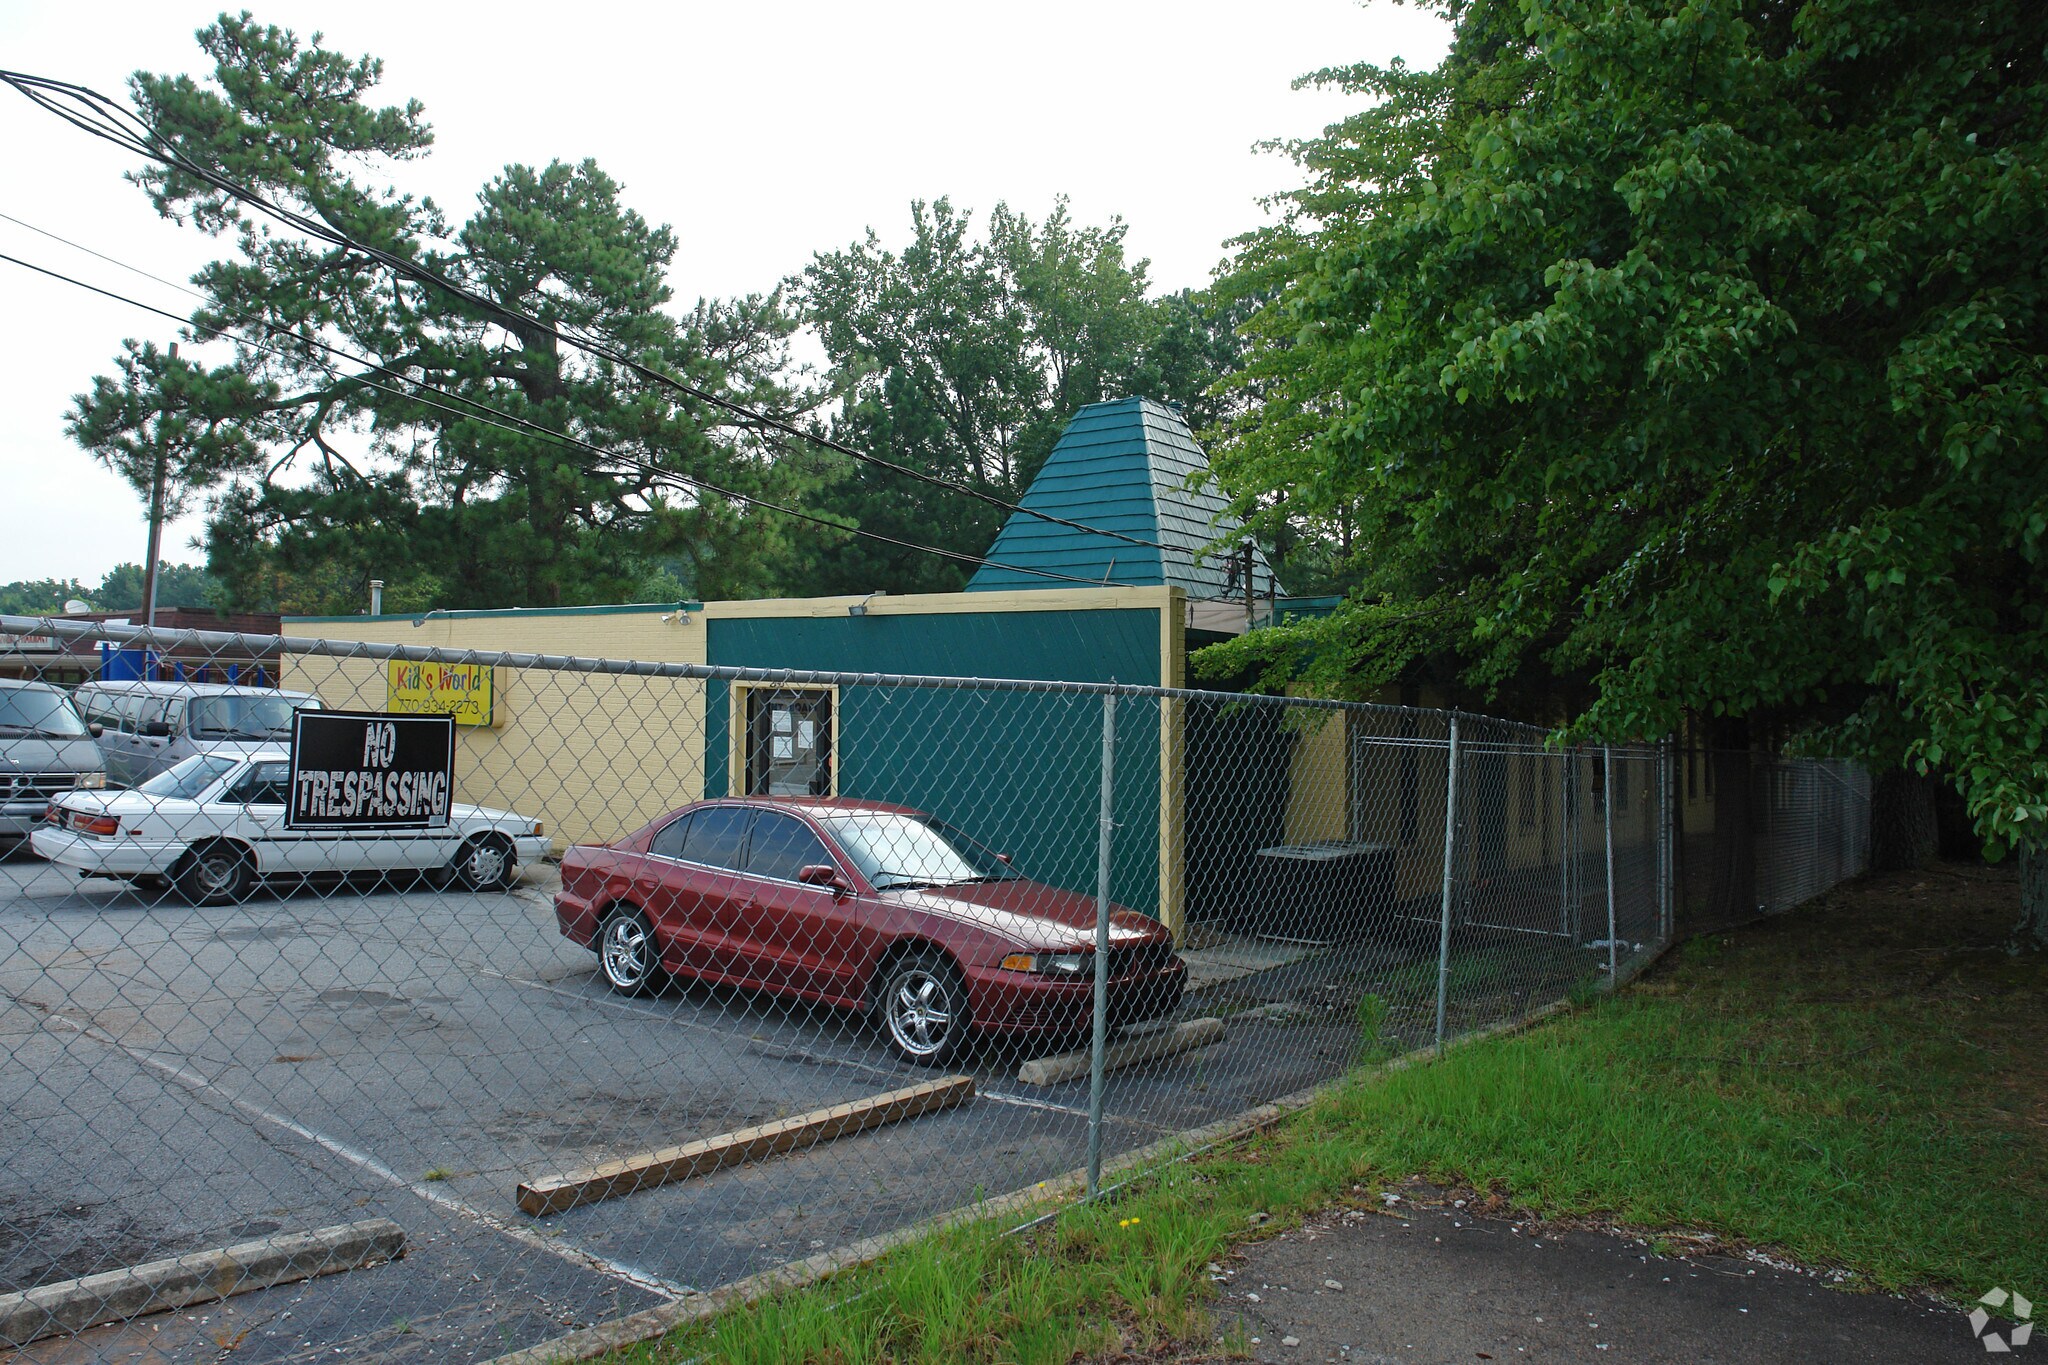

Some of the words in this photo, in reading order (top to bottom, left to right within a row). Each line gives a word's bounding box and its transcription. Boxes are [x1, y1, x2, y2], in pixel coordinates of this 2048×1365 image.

[397, 665, 433, 690] Kid's
[439, 665, 480, 691] World
[363, 721, 396, 769] NO
[298, 770, 446, 817] TRESPASSING
